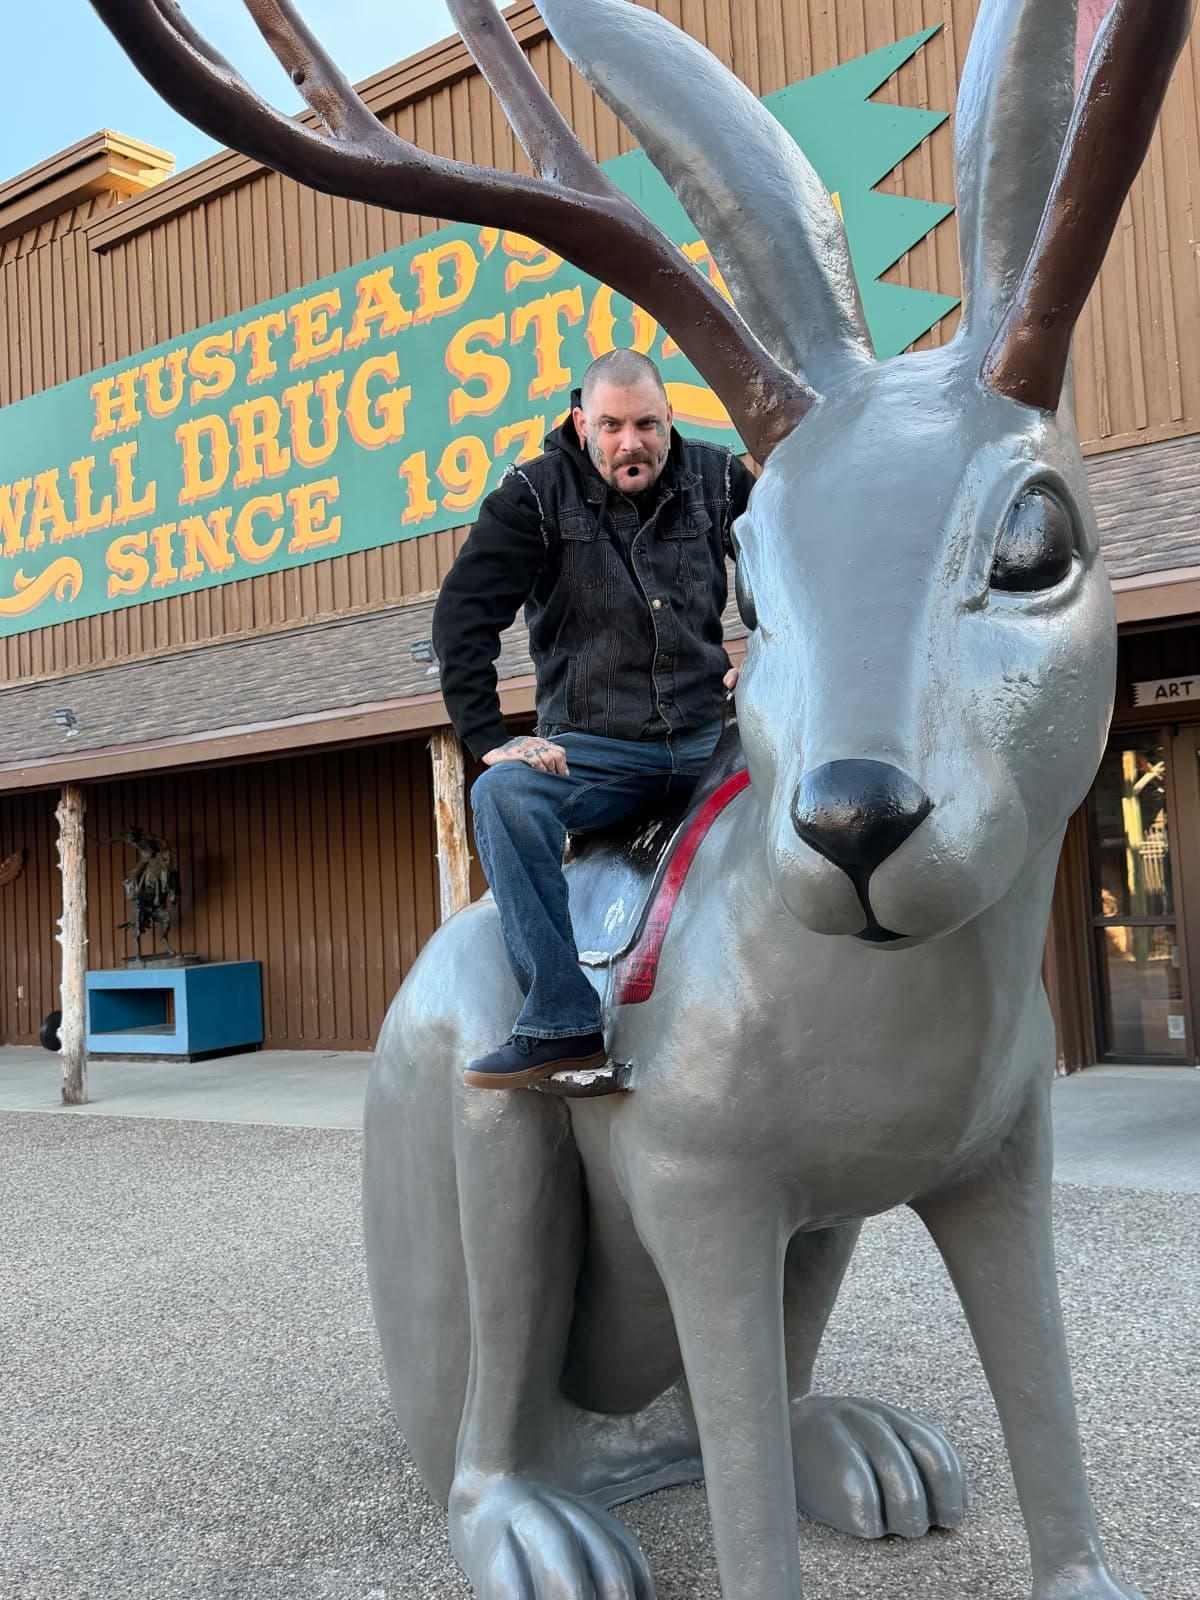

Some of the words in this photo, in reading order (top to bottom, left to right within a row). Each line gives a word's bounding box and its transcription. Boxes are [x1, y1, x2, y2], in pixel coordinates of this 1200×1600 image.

[0, 440, 156, 559] WALL
[175, 351, 411, 505] DRUG
[105, 476, 340, 597] SINCE
[1155, 680, 1194, 700] ART
